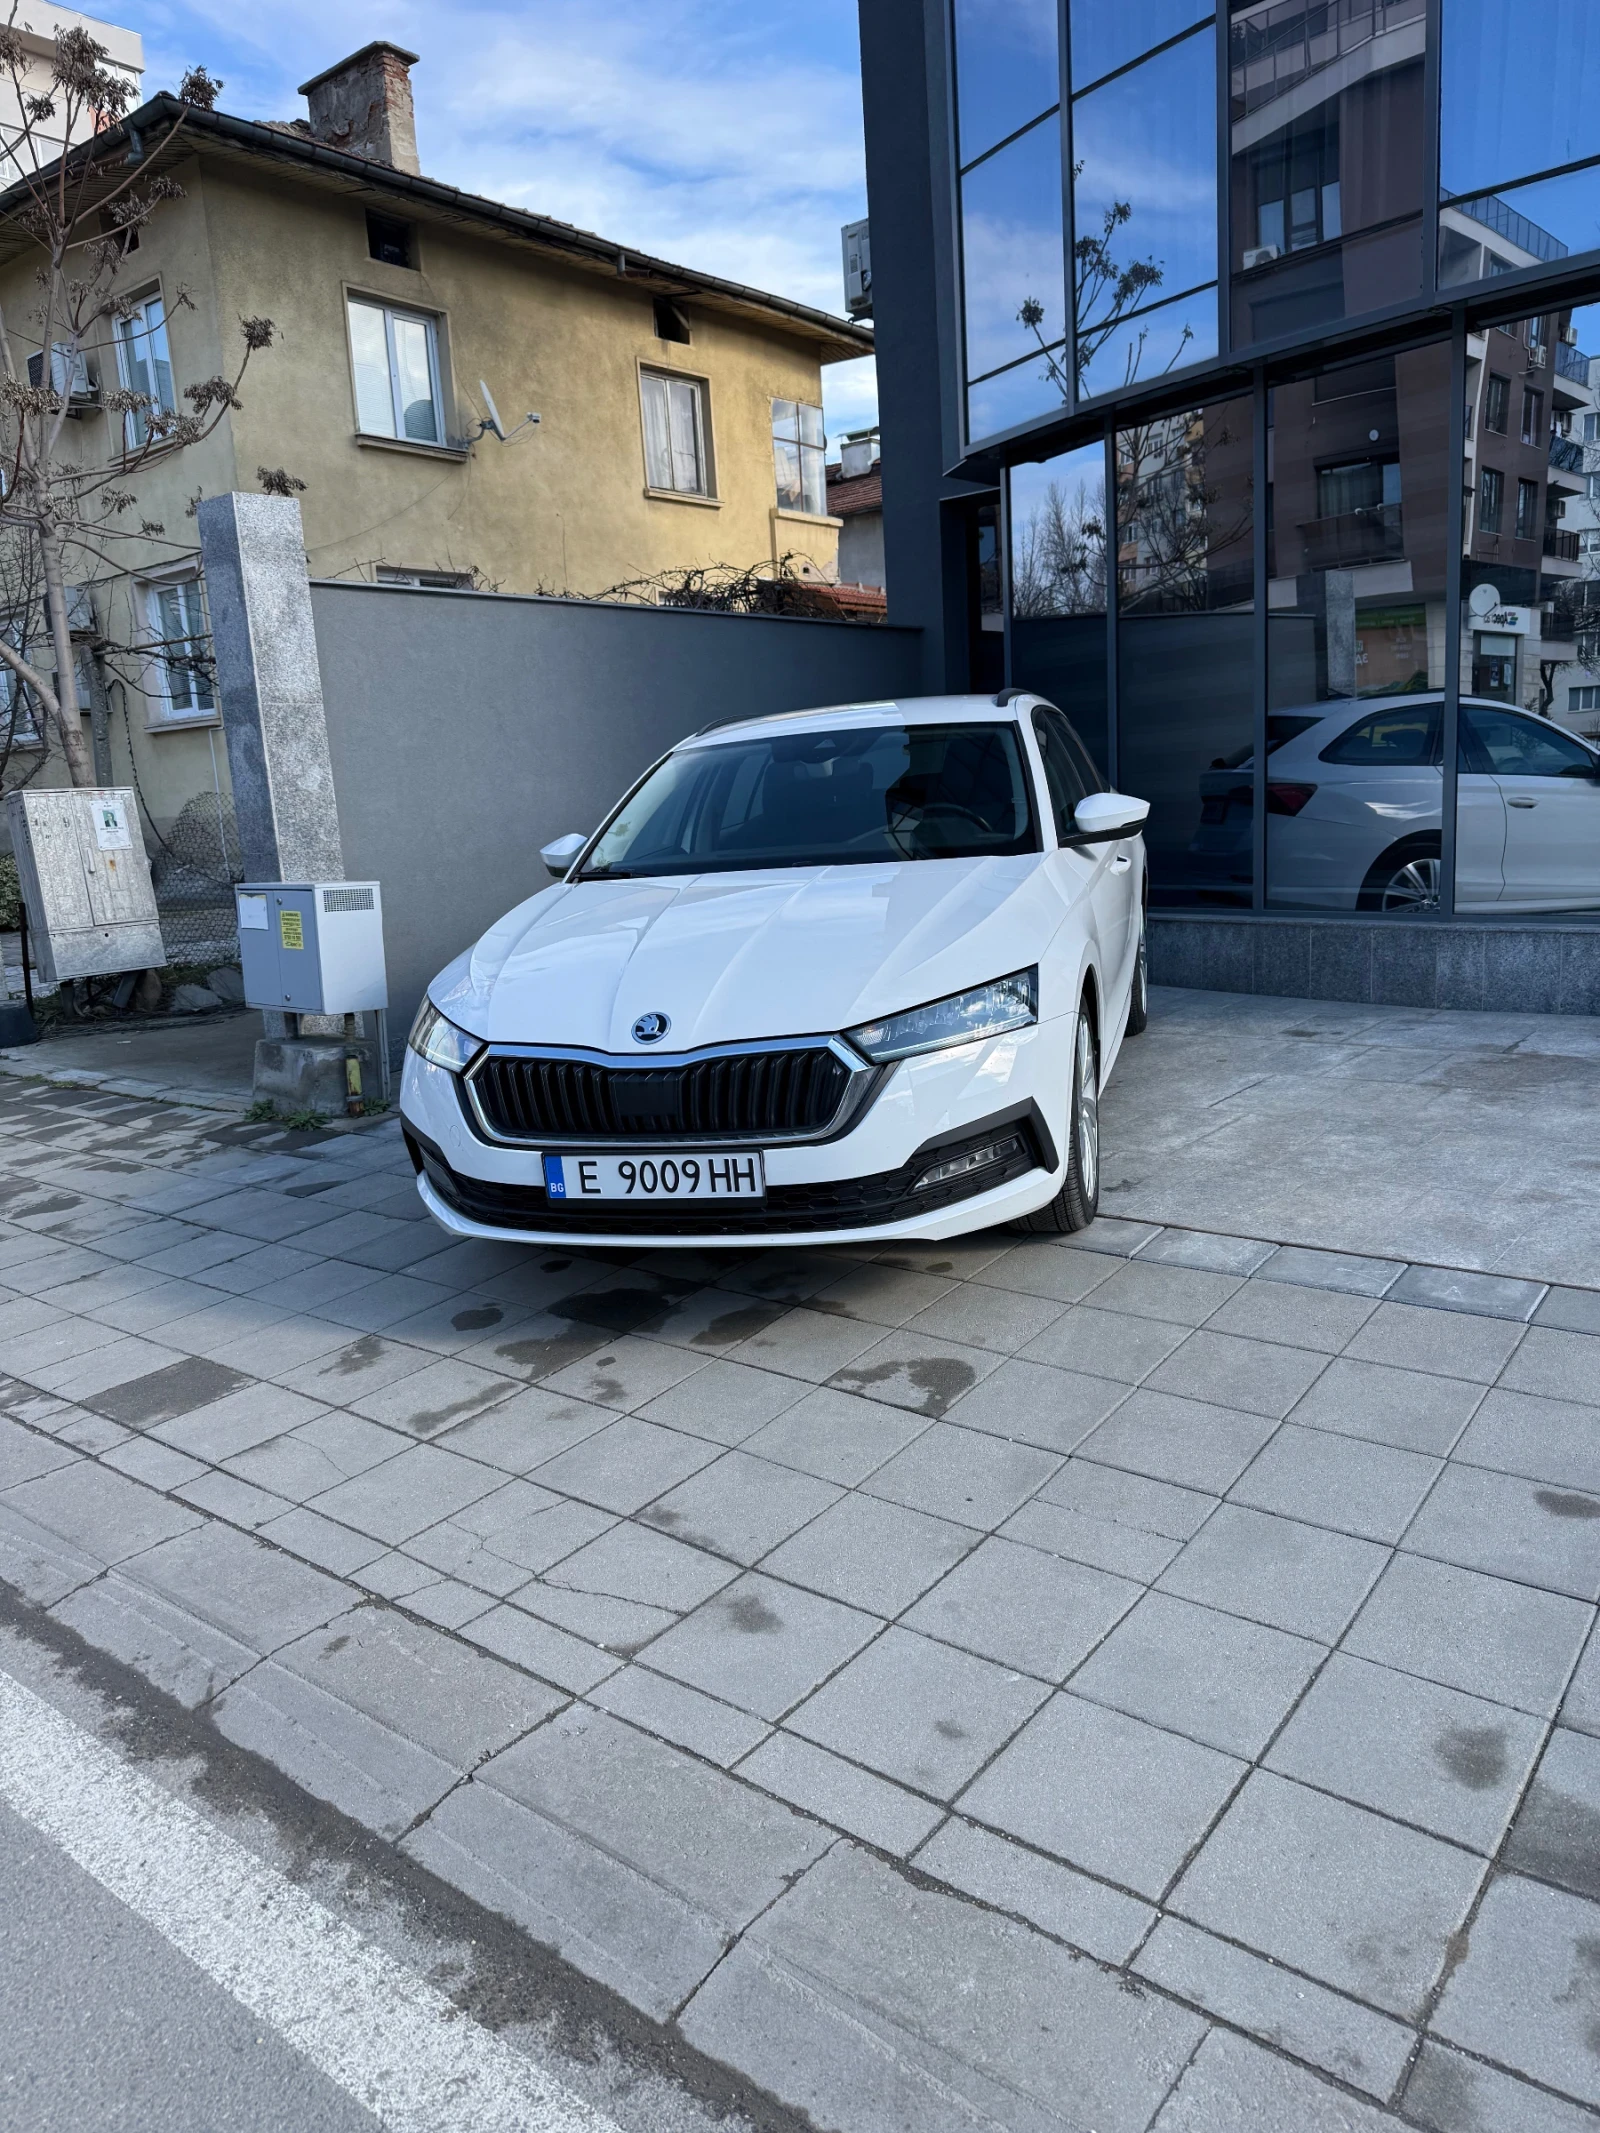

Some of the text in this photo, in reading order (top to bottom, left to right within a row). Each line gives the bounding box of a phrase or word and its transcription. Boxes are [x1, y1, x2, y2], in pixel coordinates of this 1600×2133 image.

[550, 1182, 565, 1193] BG
[578, 1158, 757, 1194] E 9009 HH
